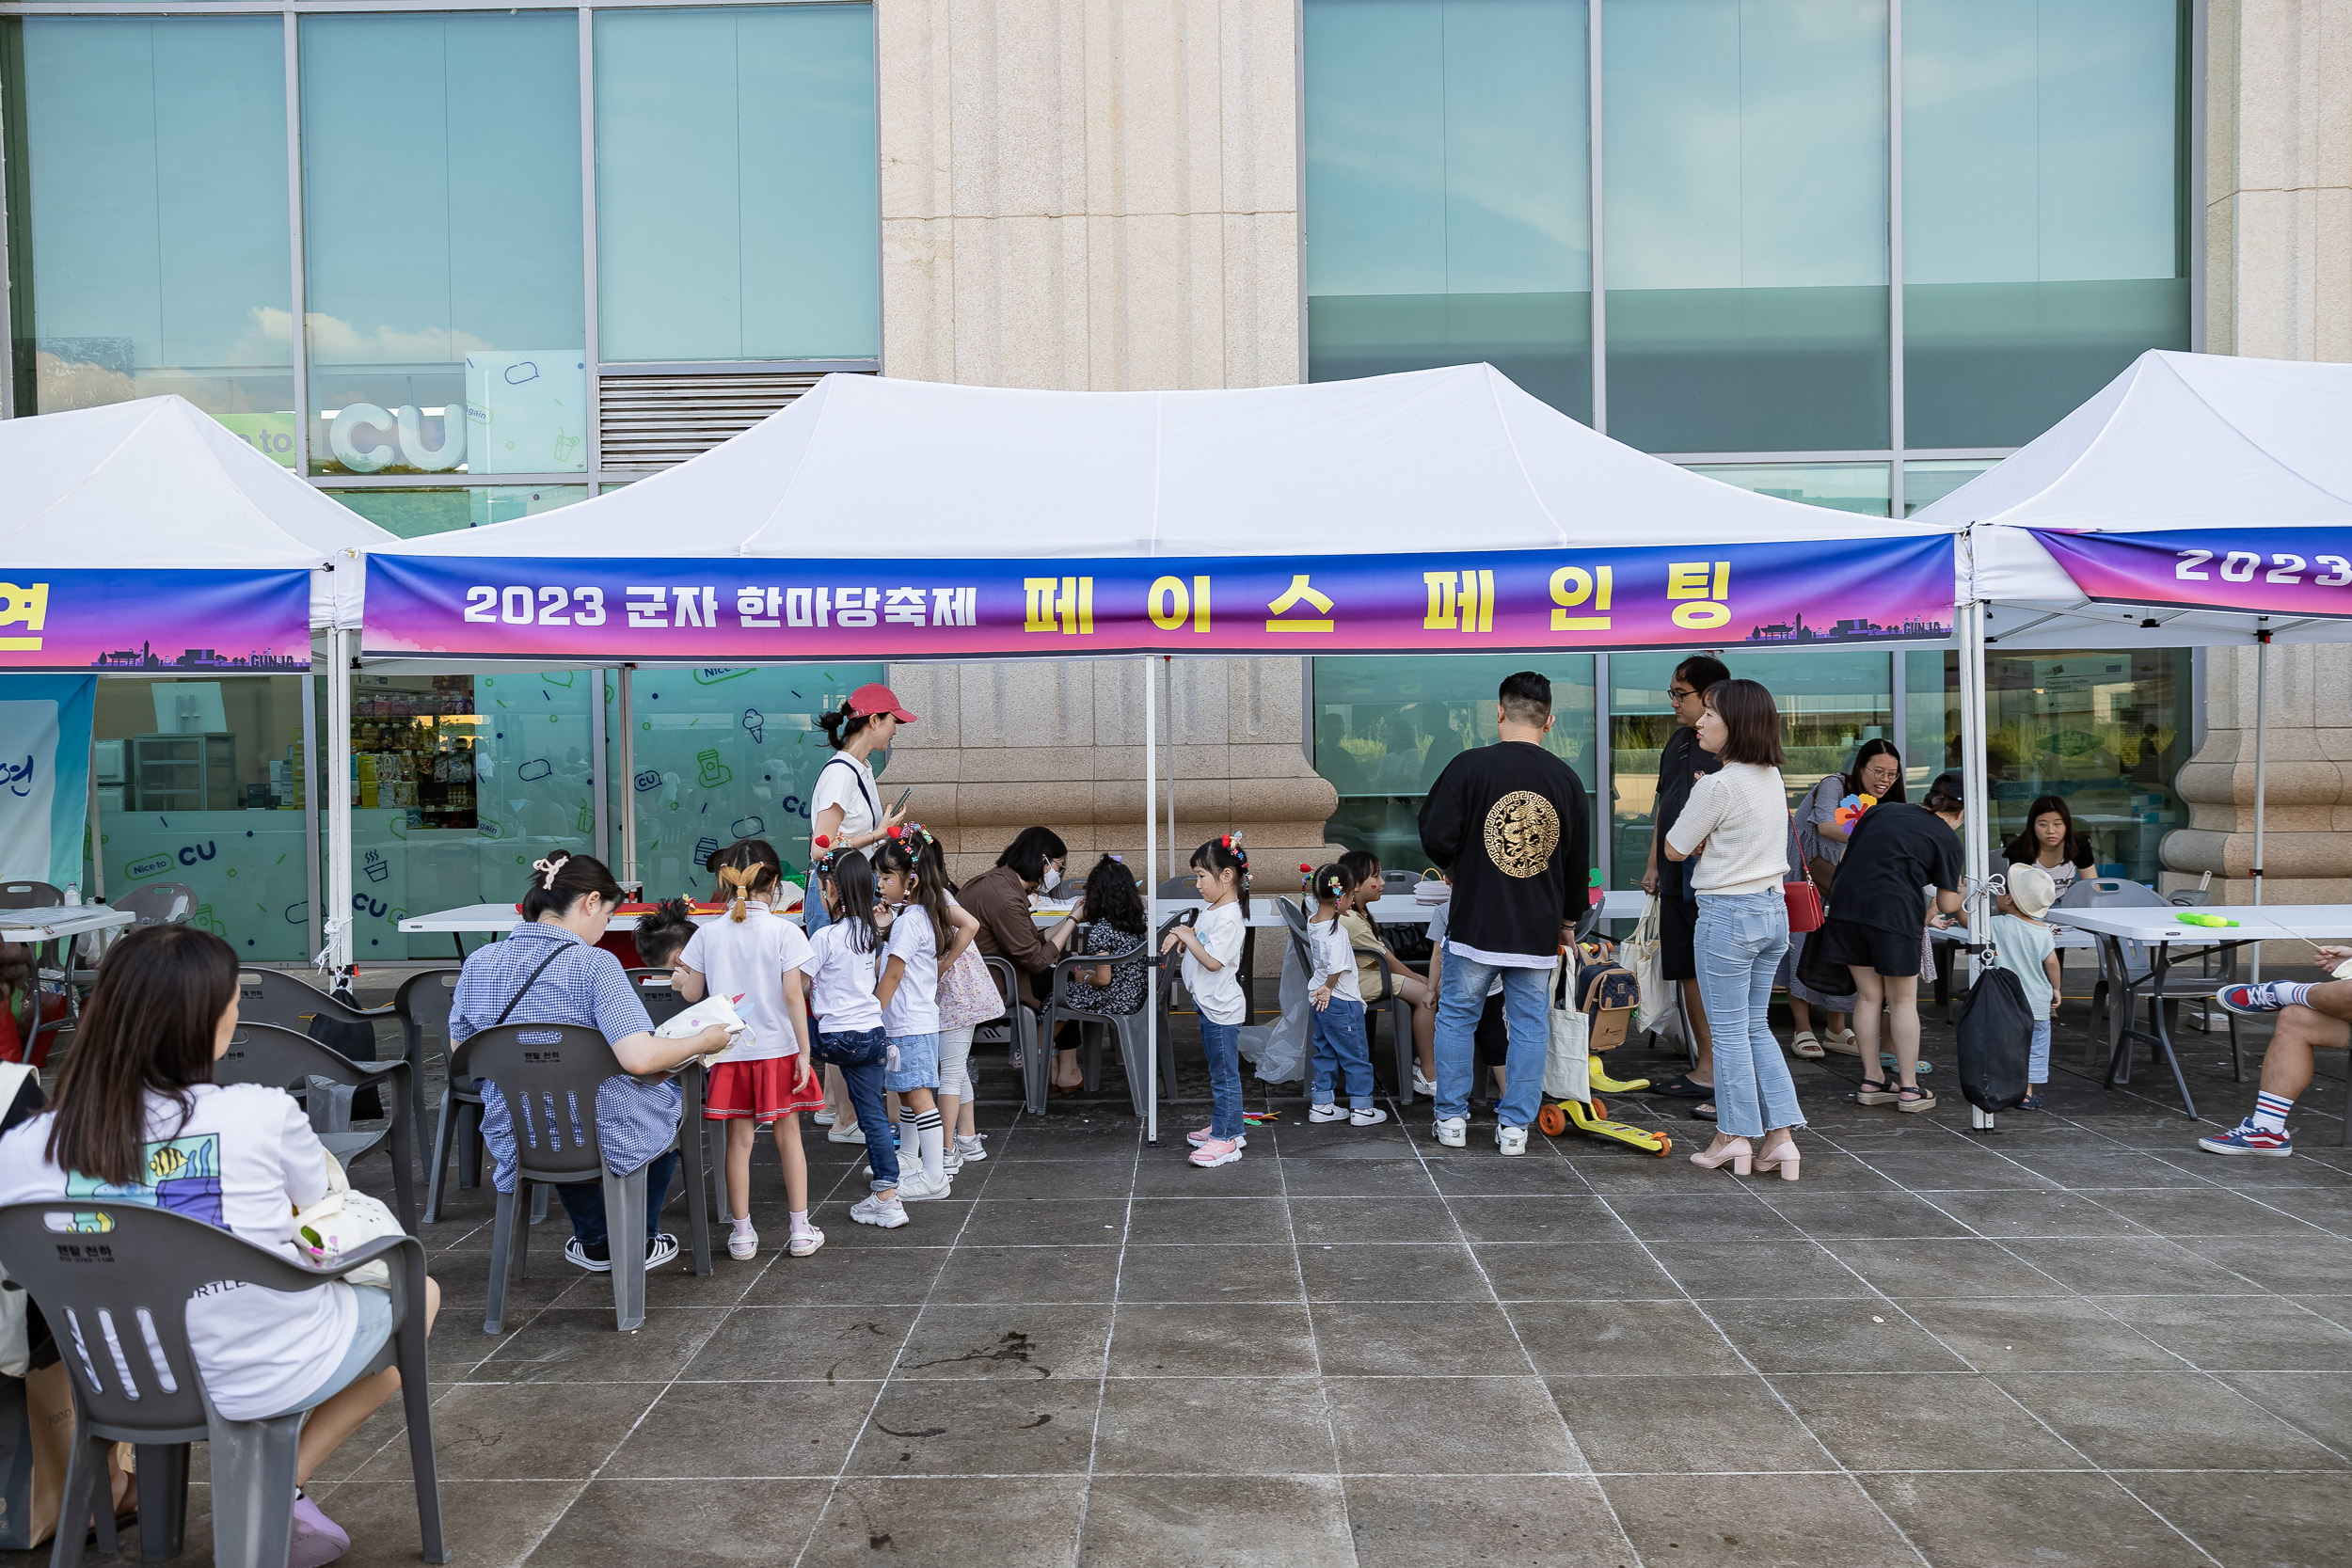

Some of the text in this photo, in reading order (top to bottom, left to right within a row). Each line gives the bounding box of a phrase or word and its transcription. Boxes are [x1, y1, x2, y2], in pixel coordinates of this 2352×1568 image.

[329, 403, 468, 472] CU
[2175, 549, 2352, 587] 2023
[464, 585, 607, 626] 2023
[625, 586, 719, 628] 군자
[737, 586, 977, 627] 한마당축제
[638, 774, 656, 787] CU
[178, 840, 216, 866] CU
[133, 863, 155, 875] Nice
[352, 893, 388, 918] CU
